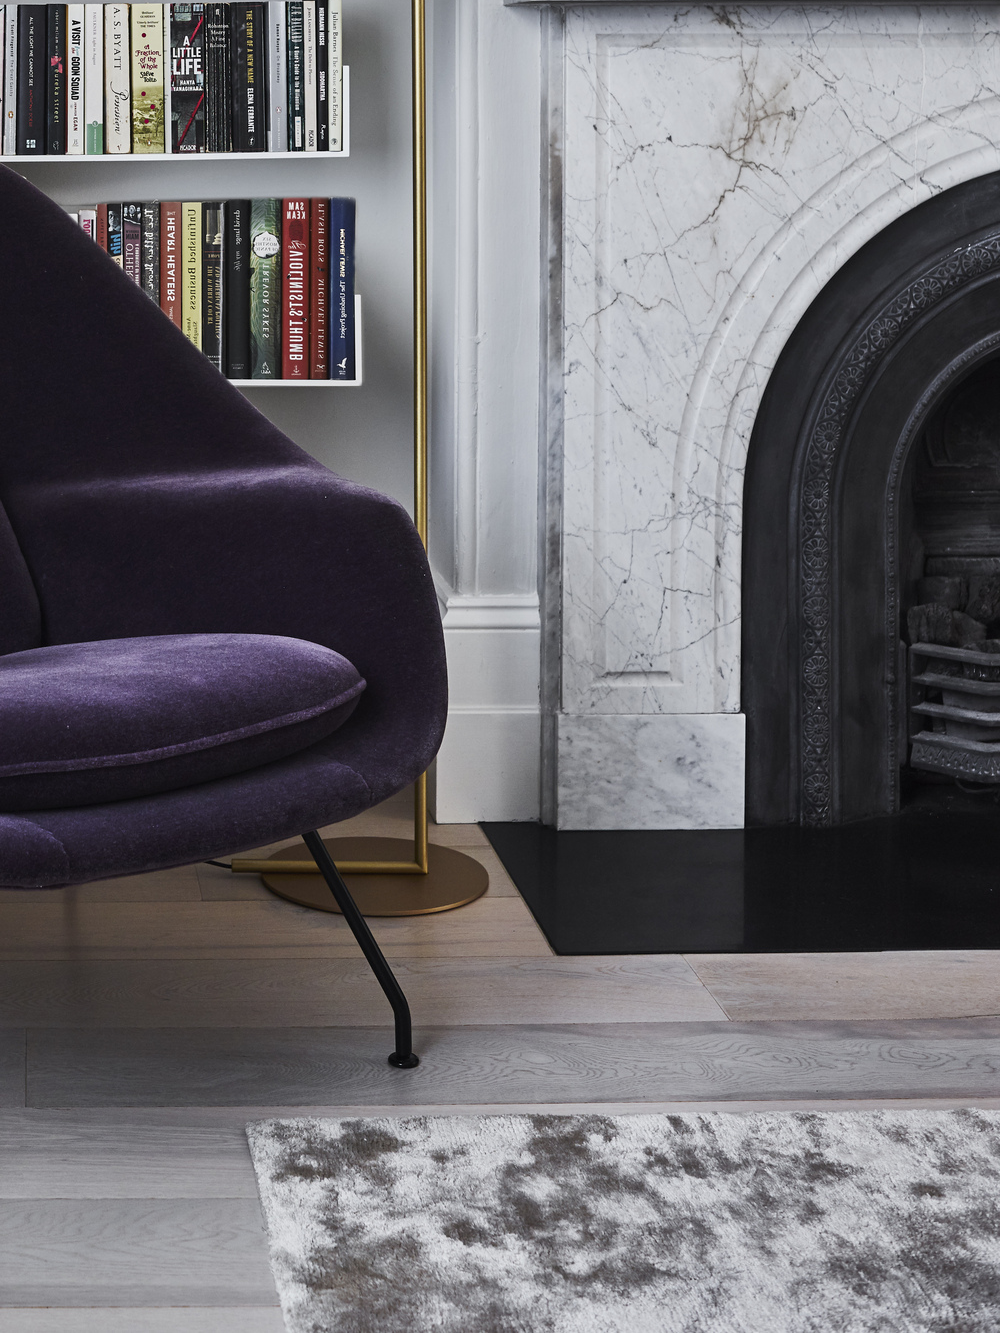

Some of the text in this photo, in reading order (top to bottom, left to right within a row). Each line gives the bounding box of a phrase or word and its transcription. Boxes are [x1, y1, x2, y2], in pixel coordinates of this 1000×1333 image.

[114, 7, 121, 18] A.
[114, 21, 121, 30] S.
[183, 36, 190, 46] A
[172, 48, 201, 57] LITTLE
[172, 59, 201, 74] LIFE
